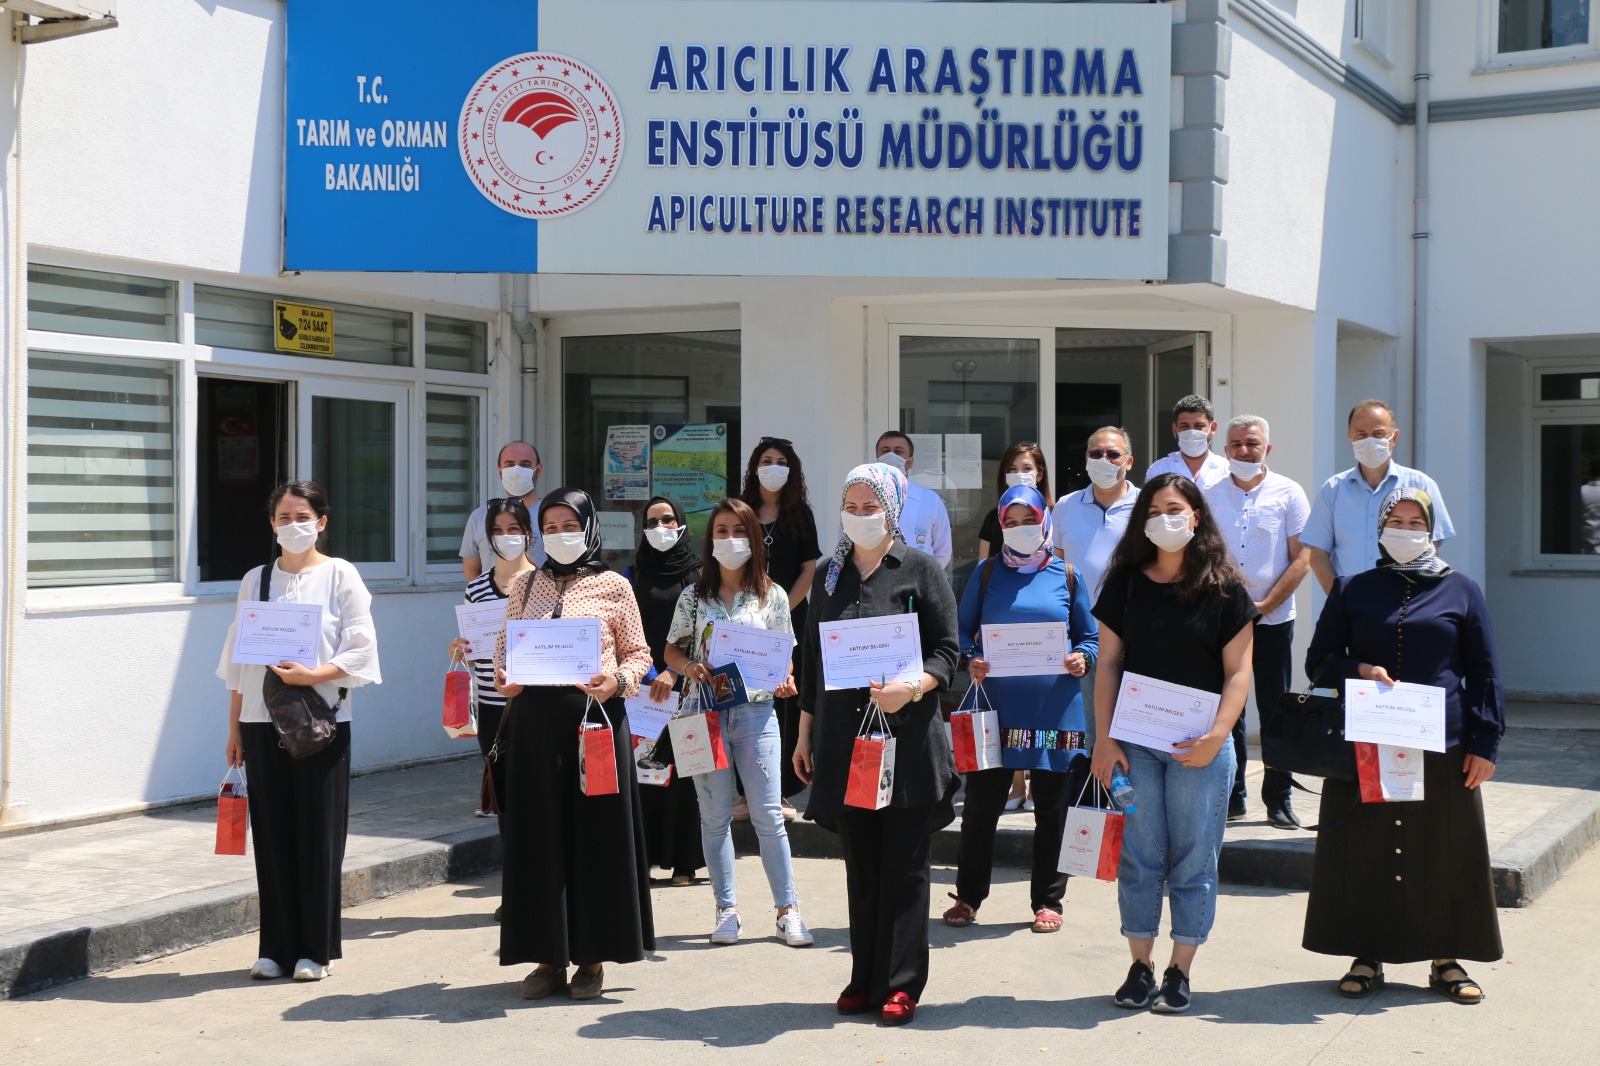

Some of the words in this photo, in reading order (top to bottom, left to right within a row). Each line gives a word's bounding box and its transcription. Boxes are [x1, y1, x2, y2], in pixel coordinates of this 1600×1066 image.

[357, 75, 388, 104] T.C.
[648, 44, 852, 94] ARICILIK
[867, 46, 1143, 108] ARAŞTIRMA
[296, 118, 351, 148] TARIM
[355, 127, 376, 148] ve
[381, 119, 447, 148] ORMAN
[647, 106, 863, 169] ENSTİTÜSÜ
[878, 107, 1144, 172] MÜDÜRLÜĞÜ
[325, 156, 420, 192] BAKANLIĞI
[647, 195, 824, 233] APICULTURE
[836, 197, 984, 235] RESEARCH
[995, 198, 1142, 238] INSTITUTE
[298, 318, 311, 331] 7/24
[312, 320, 328, 333] SAAT
